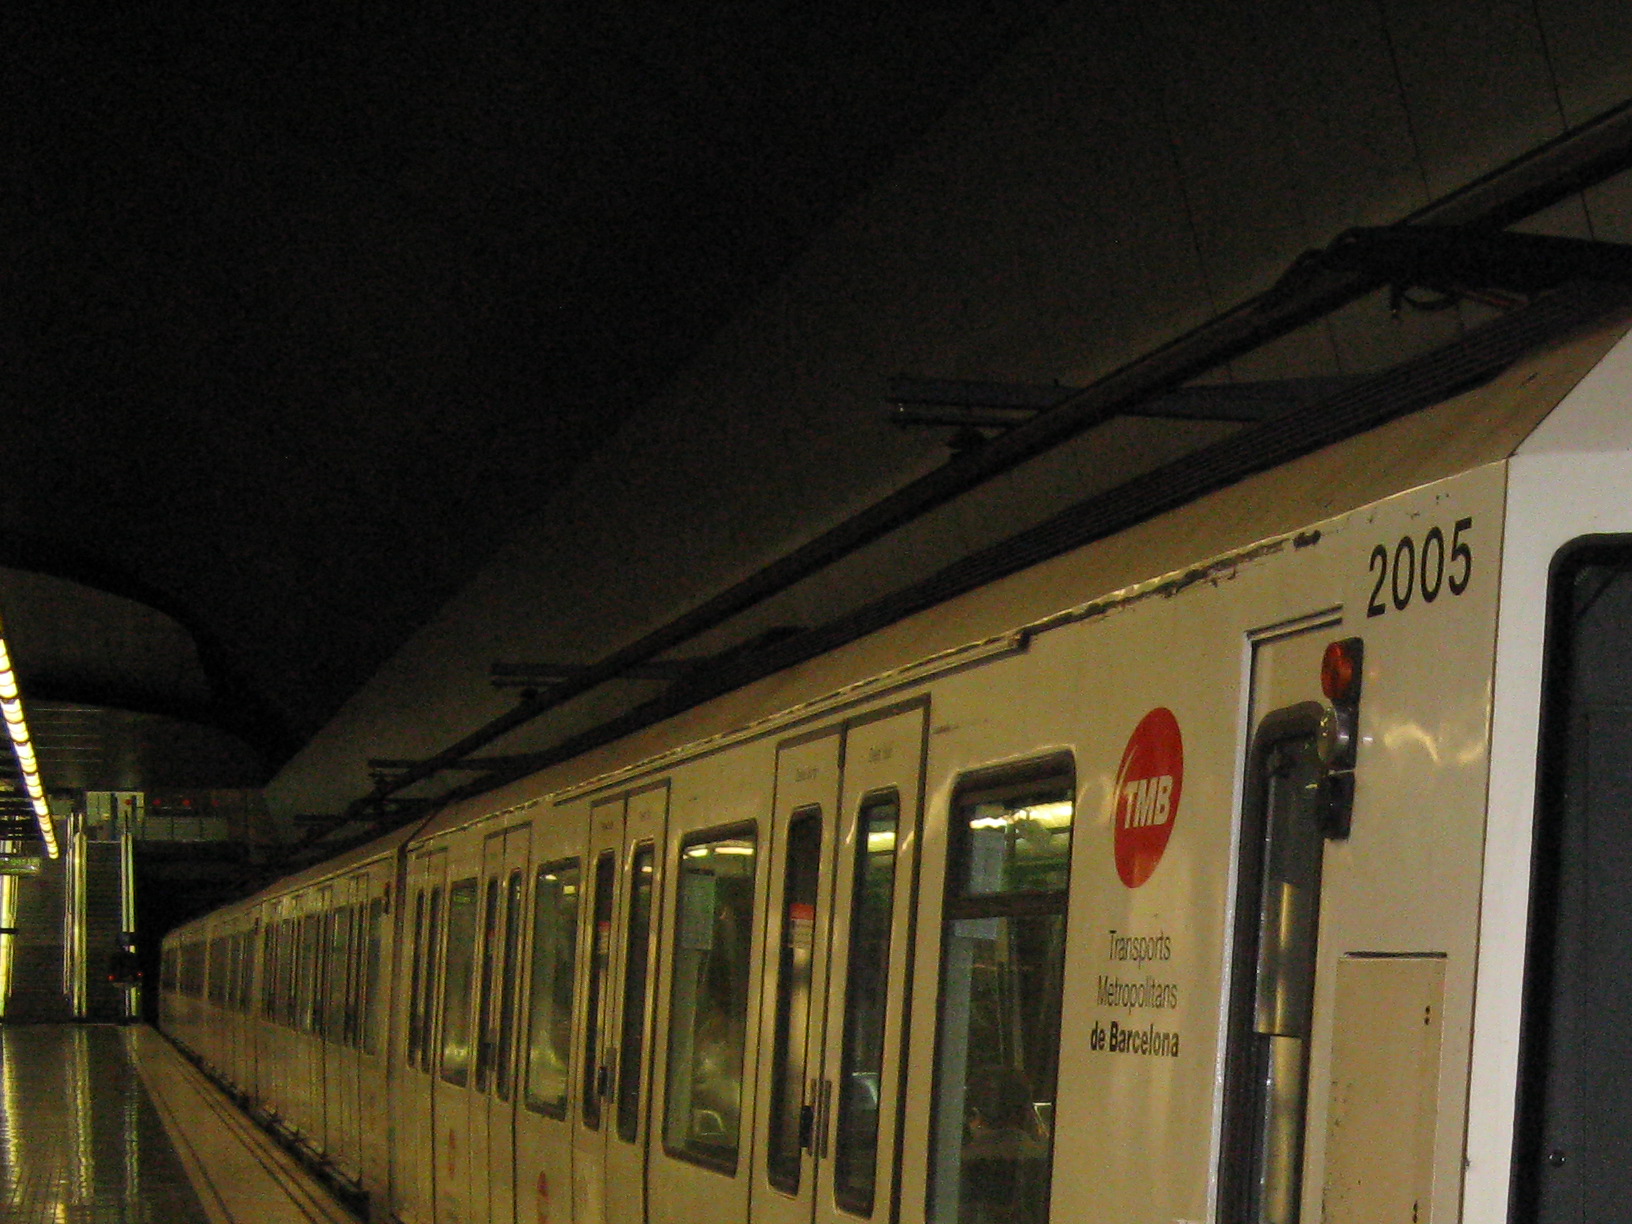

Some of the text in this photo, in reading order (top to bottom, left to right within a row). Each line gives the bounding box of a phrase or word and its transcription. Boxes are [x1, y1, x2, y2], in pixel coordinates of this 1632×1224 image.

[1367, 516, 1472, 618] 2005
[1124, 775, 1173, 829] TMB
[1108, 930, 1171, 969] Transports
[1097, 974, 1177, 1015] Metropolitans
[1090, 1020, 1179, 1057] de Barcelona
